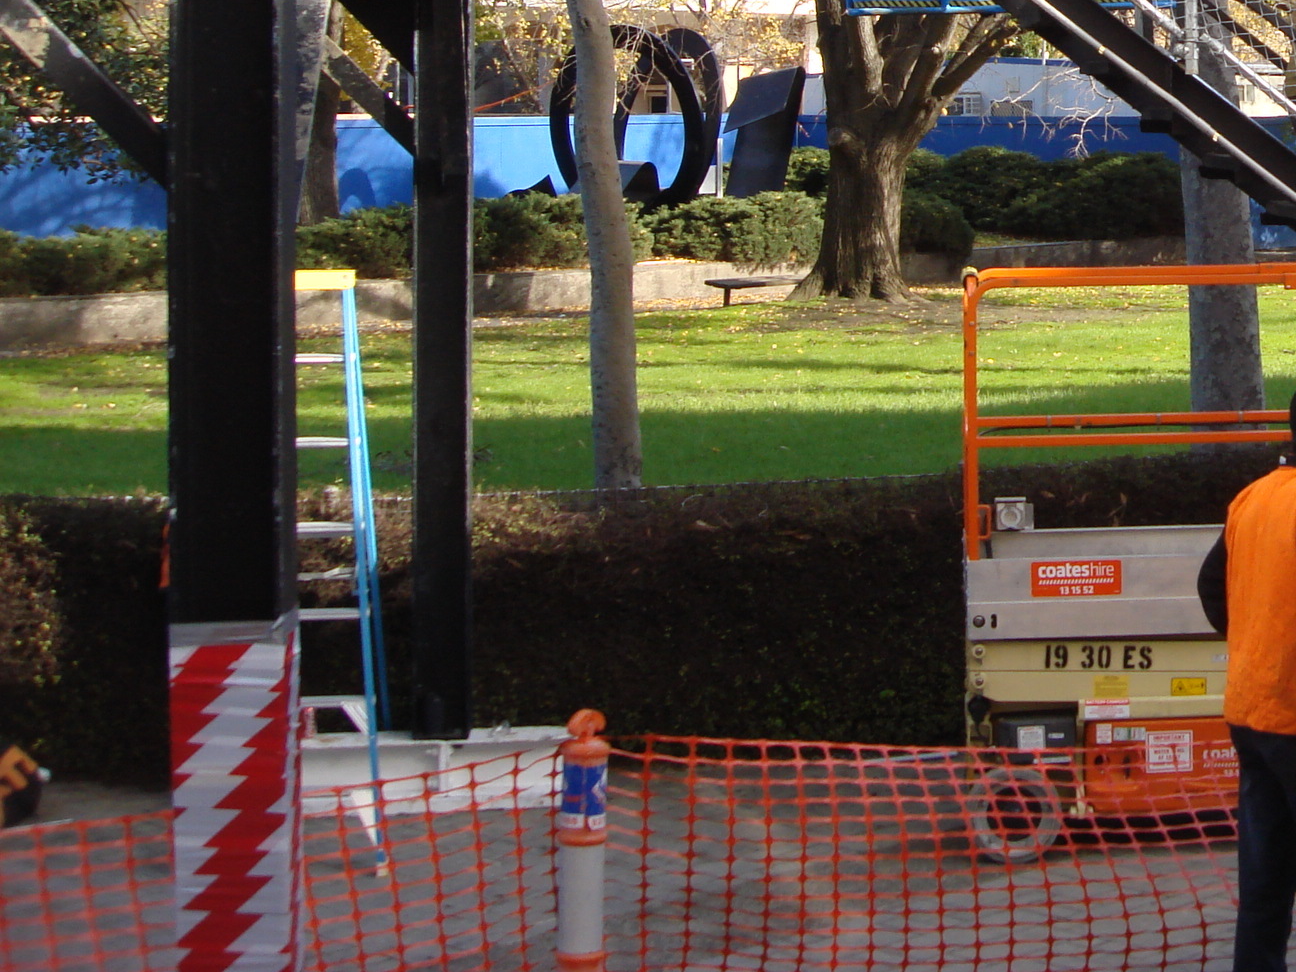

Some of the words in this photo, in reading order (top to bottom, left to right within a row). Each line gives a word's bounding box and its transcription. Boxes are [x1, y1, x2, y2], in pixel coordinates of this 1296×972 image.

[1060, 586, 1070, 595] 13
[1071, 586, 1082, 595] 15
[1083, 585, 1095, 595] 52
[1045, 645, 1069, 669] 19
[1081, 645, 1112, 669] 30
[1123, 645, 1153, 669] ES
